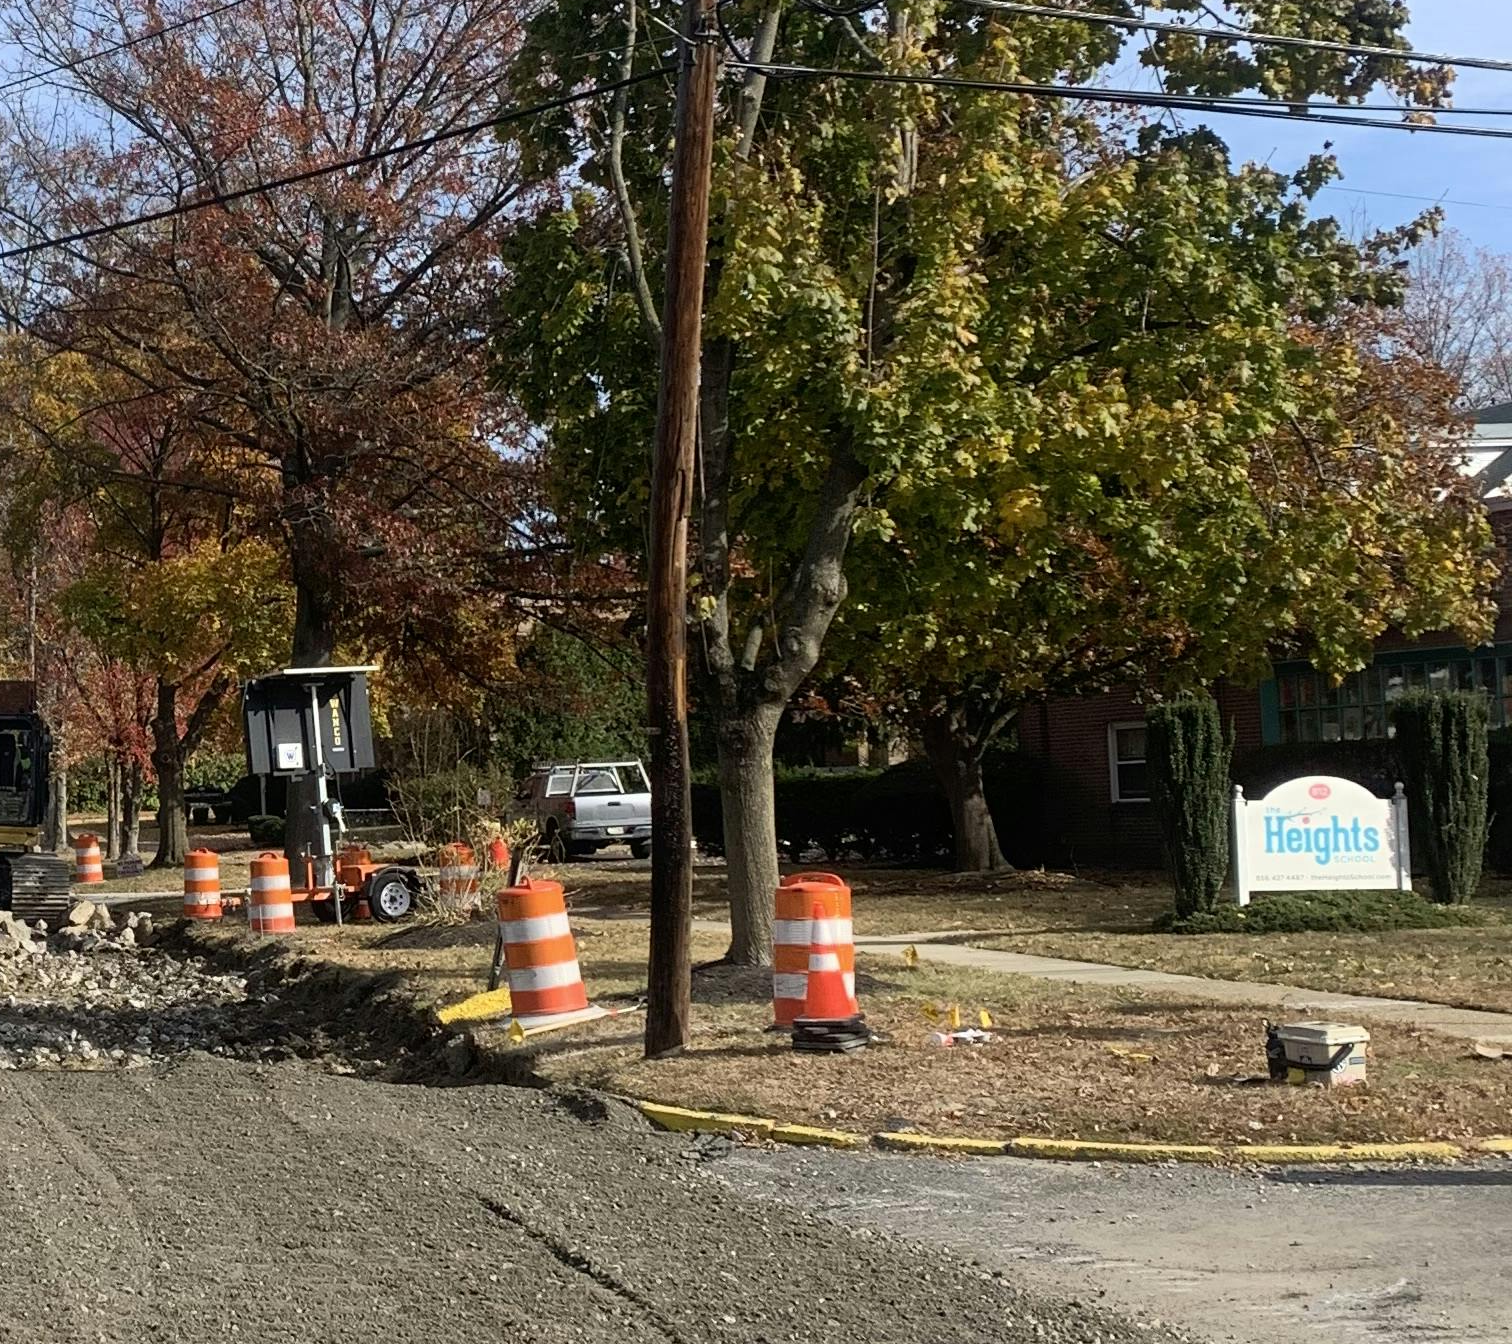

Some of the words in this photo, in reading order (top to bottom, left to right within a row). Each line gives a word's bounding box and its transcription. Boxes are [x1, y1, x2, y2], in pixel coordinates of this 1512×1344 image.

[329, 698, 341, 746] WANCO
[1264, 815, 1380, 865] Heights
[1333, 855, 1377, 864] SCHOOL
